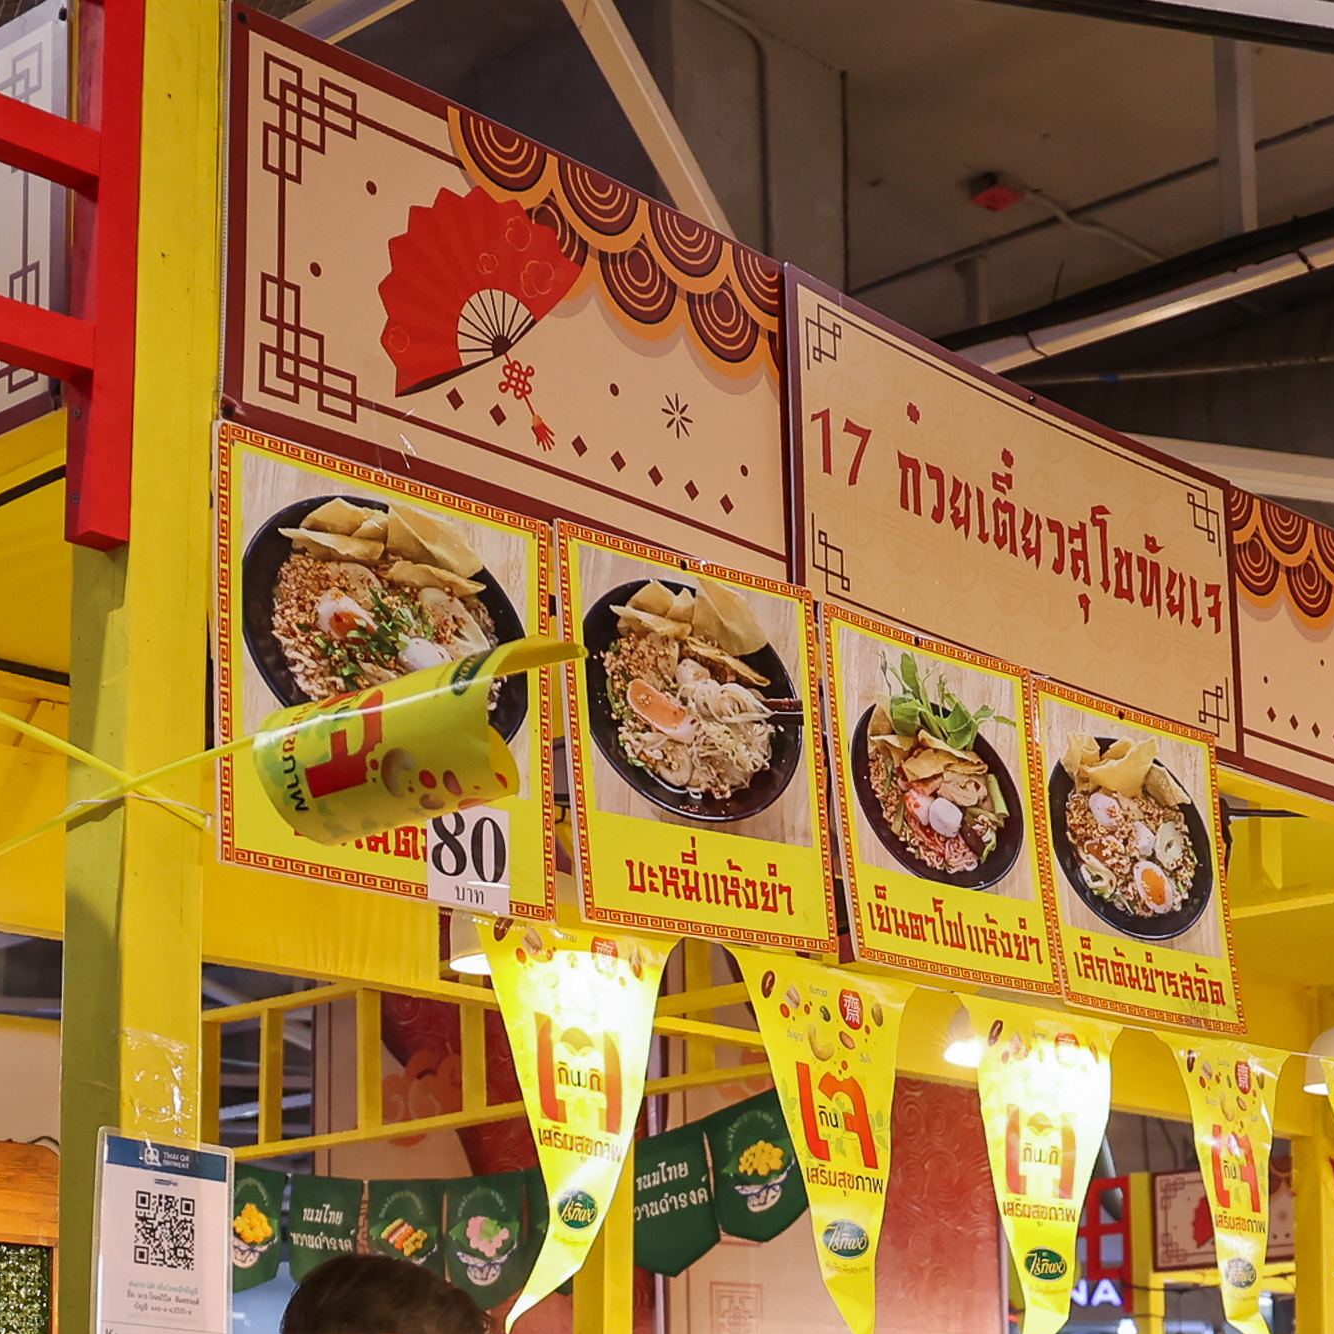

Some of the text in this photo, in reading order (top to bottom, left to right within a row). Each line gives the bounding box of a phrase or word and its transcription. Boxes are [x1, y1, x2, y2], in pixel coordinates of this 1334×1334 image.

[811, 402, 1222, 634] 17 ก๋วยเตี๋ยวสุโขทัยเจ
[430, 811, 507, 883] 80
[625, 836, 795, 916] บะหมี่แห้งยำ
[455, 884, 485, 905] บาท
[867, 884, 1044, 965] เย็นตาโฟแห้งยำ
[1072, 935, 1227, 1007] เล็กต้มยำรสจัด
[796, 1061, 879, 1170] เจ
[818, 1104, 839, 1129] กิน
[633, 1174, 708, 1221] วานดำรงค์
[807, 1163, 884, 1197] เสริมสุขภาพ
